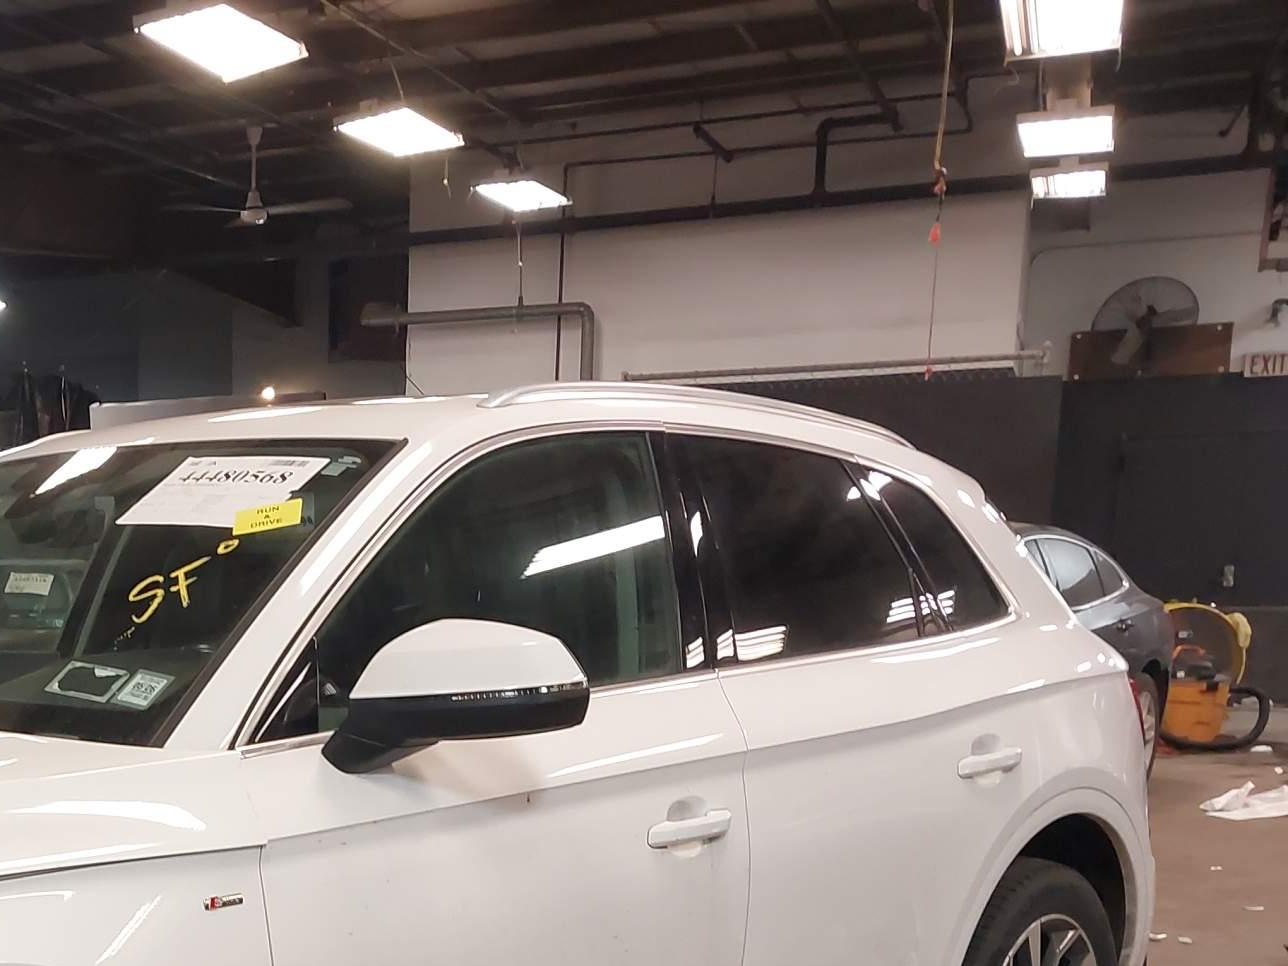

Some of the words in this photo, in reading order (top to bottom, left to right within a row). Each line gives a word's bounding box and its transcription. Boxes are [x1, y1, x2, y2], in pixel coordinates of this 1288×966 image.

[1250, 353, 1288, 375] EXIT
[179, 470, 294, 485] 44480568
[256, 505, 280, 515] RUN
[250, 518, 283, 529] DRIVE
